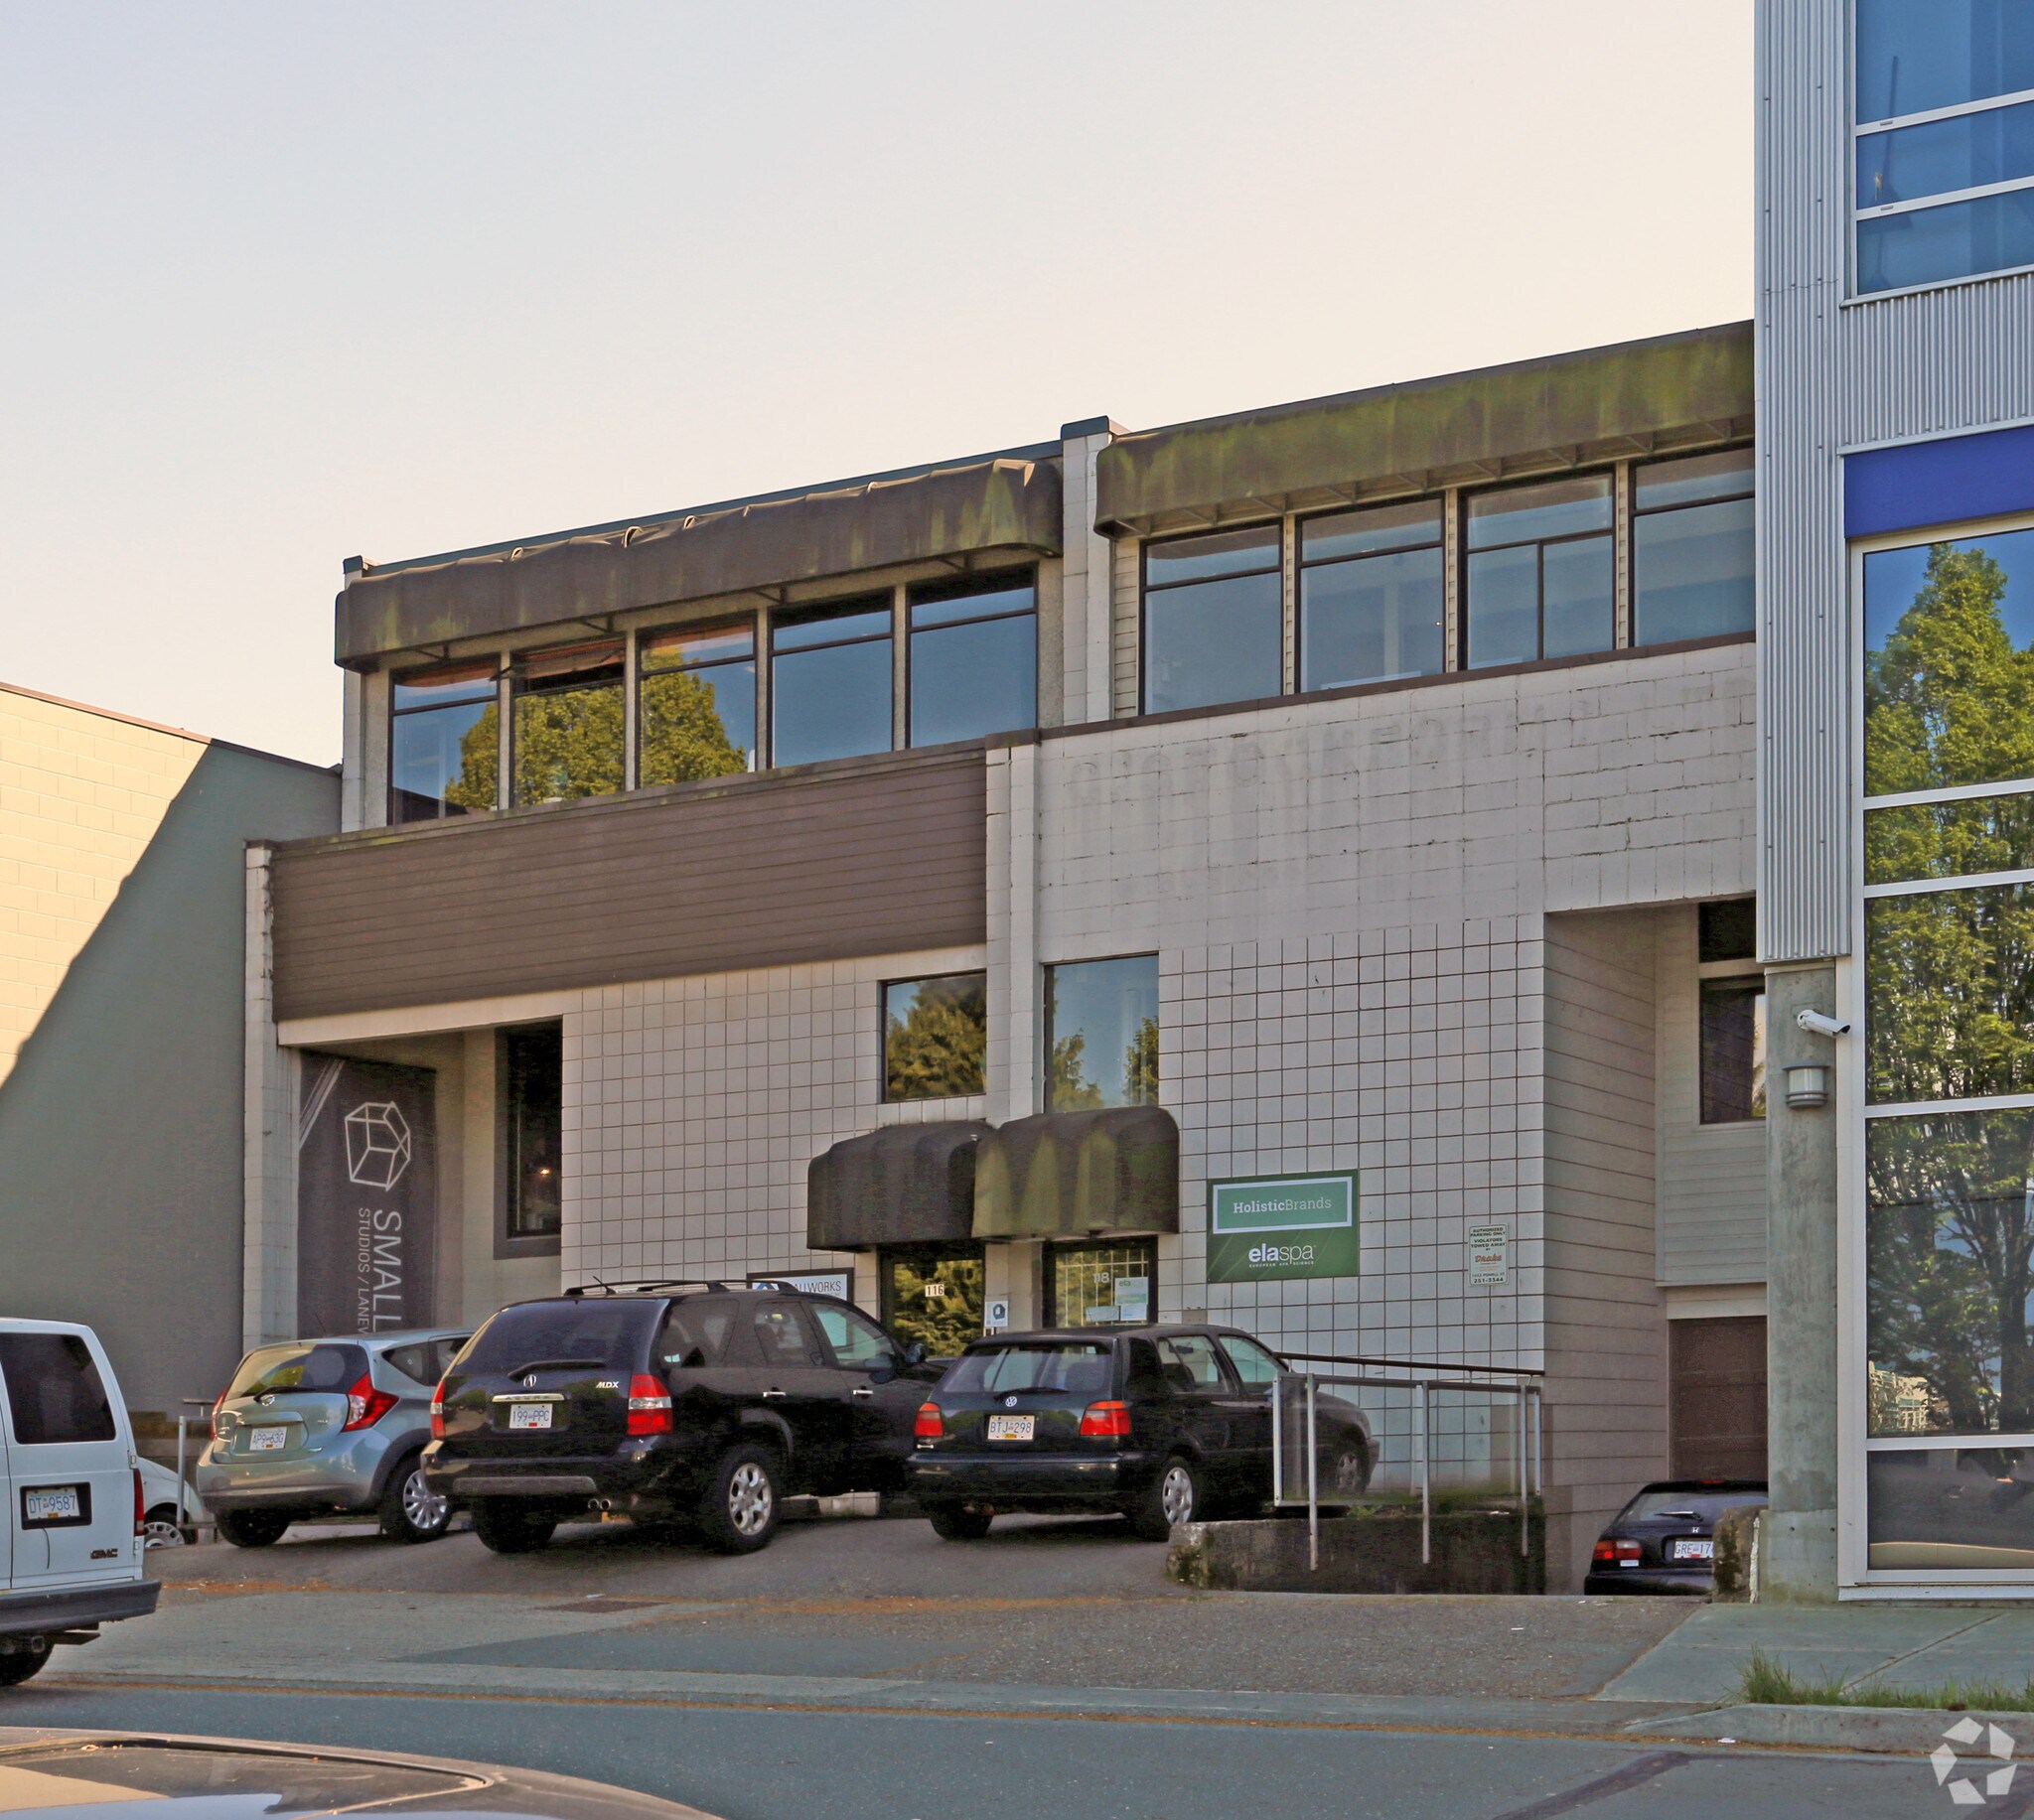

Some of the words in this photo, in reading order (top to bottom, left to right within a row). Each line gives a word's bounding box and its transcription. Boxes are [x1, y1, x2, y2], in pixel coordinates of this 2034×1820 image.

[1233, 1196, 1332, 1213] HolisticBrands
[358, 1207, 370, 1273] STUDIOS
[1248, 1243, 1314, 1265] elaspa
[1475, 1253, 1502, 1262] Drake
[373, 1209, 401, 1331] SMALL
[1093, 1272, 1109, 1284] 118
[927, 1285, 944, 1295] 116
[90, 1548, 118, 1560] GMC
